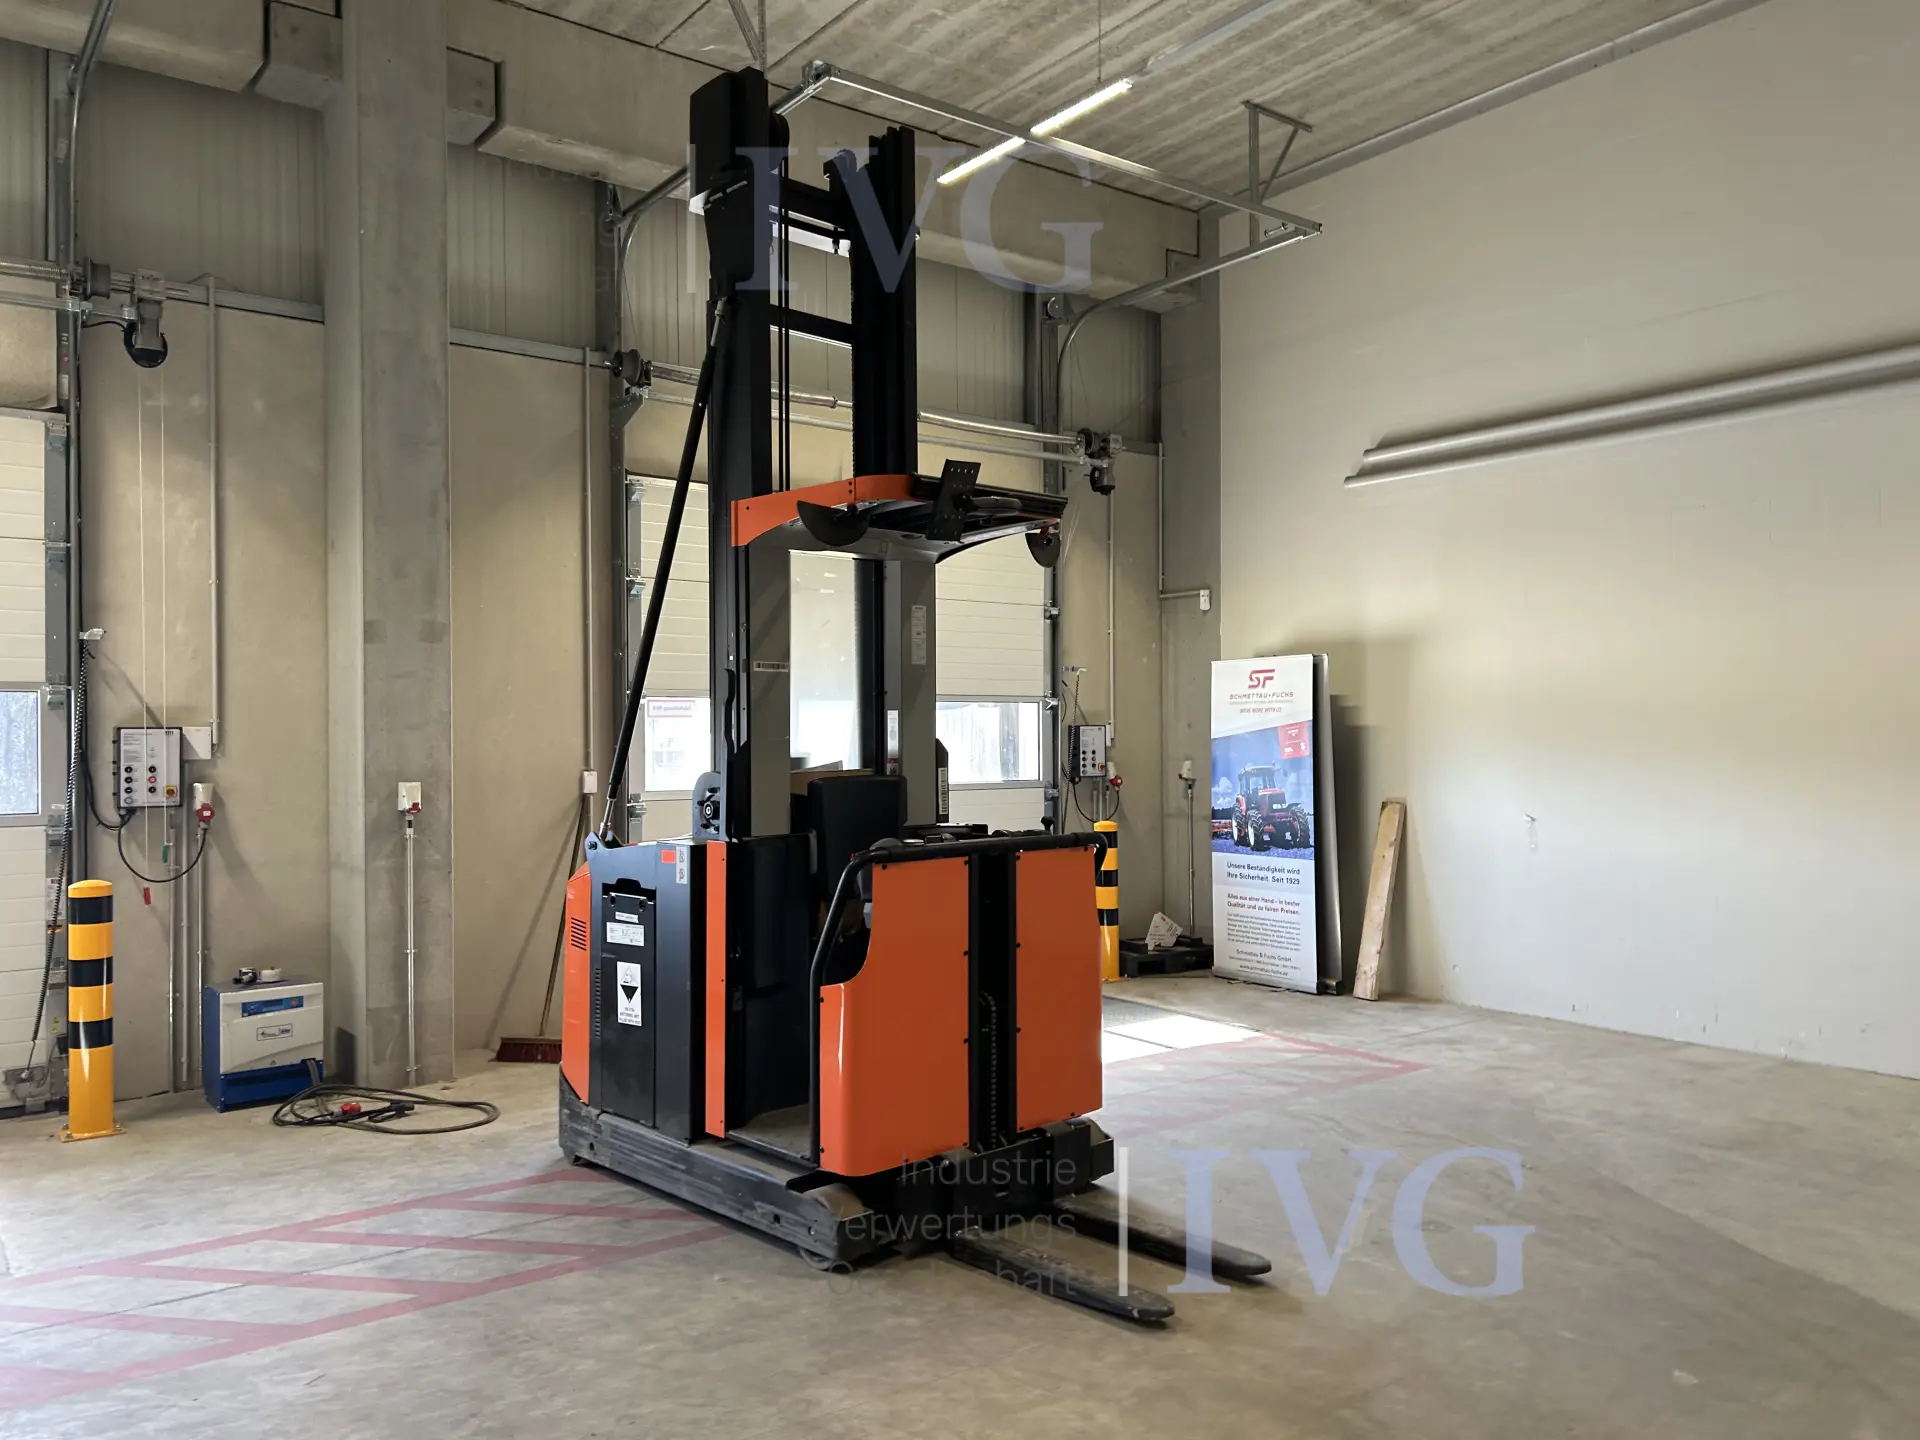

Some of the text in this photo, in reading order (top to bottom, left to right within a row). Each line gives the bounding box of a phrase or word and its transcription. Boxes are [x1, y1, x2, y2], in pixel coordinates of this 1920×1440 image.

[1248, 669, 1276, 689] SF
[1229, 691, 1294, 700] SCHMETTAU+FUCHS
[1226, 861, 1246, 870] Unsere
[1246, 863, 1286, 875] Beständigkeit
[1226, 871, 1300, 885] Ihre Sicherheit. Seit 1929
[1227, 900, 1246, 909] Qualität
[1246, 902, 1257, 910] und
[1264, 904, 1280, 912] fairen
[1248, 895, 1260, 903] einer
[1260, 896, 1275, 904] Hand
[1284, 899, 1301, 907] bester
